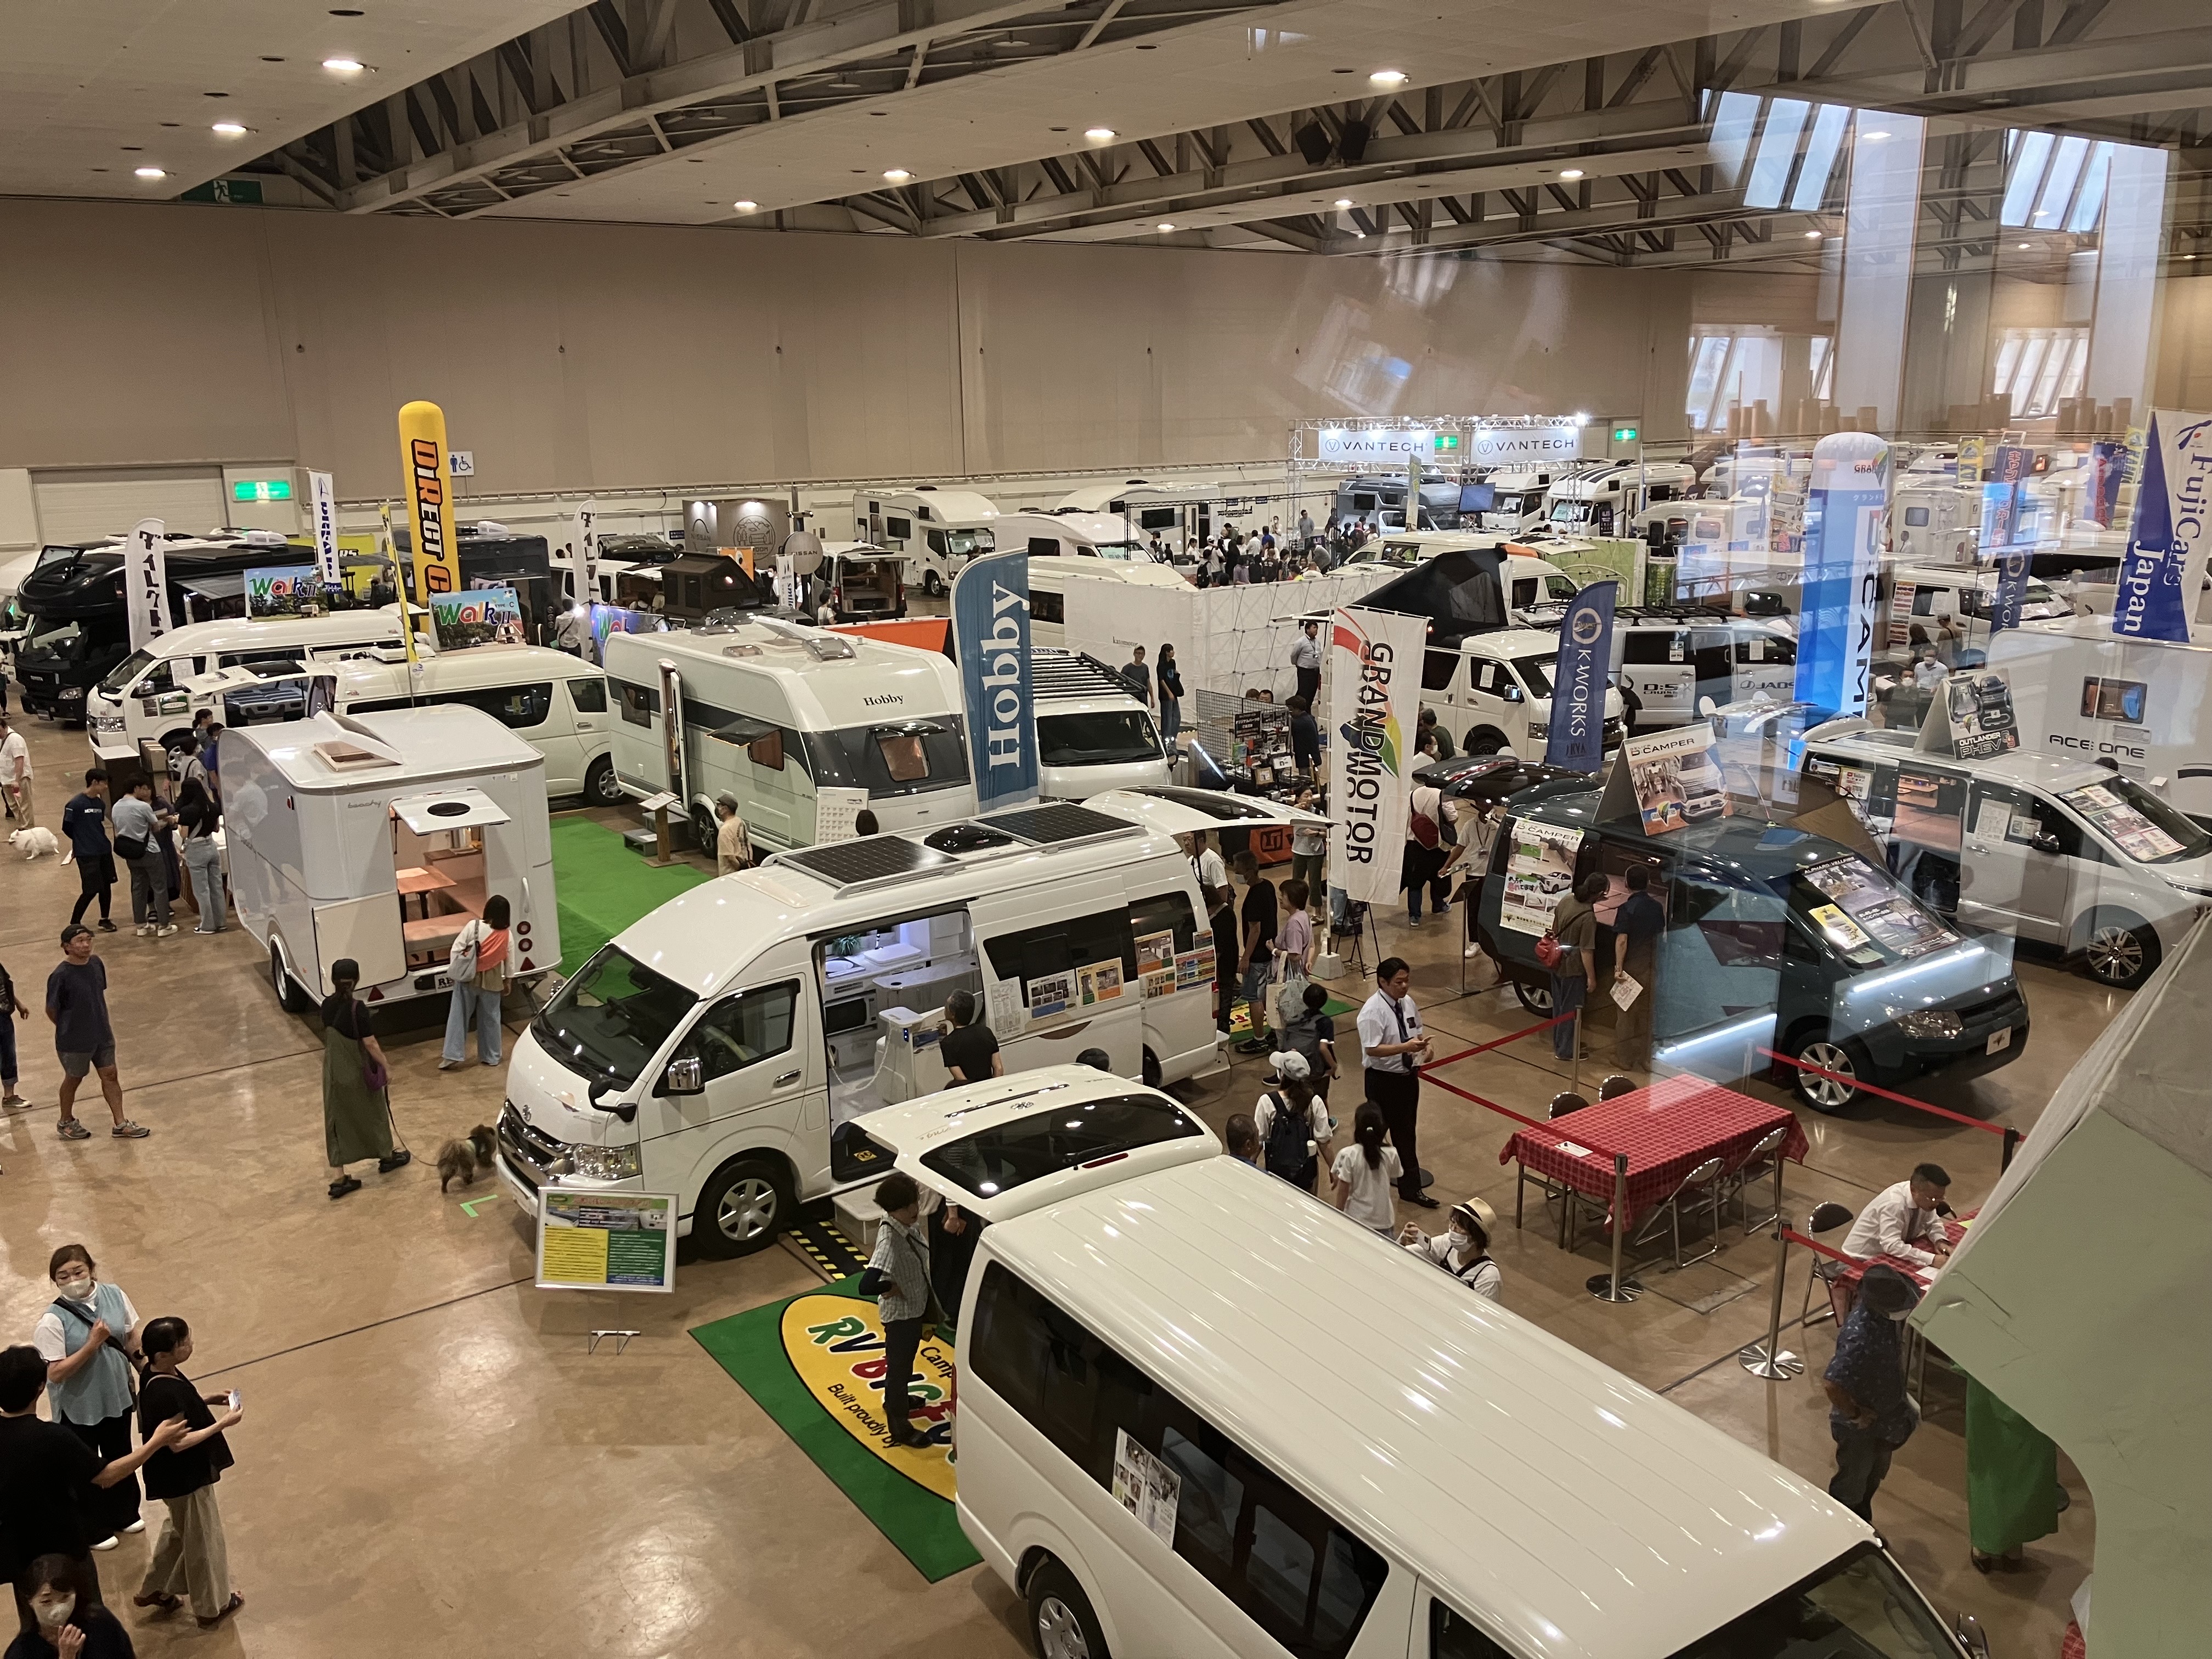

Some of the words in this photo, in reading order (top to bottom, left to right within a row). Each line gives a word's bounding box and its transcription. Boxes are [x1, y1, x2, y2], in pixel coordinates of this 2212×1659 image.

[1342, 441, 1424, 452] VANTECH
[1496, 439, 1575, 451] VANTECH
[411, 439, 445, 561] DIRECT
[249, 577, 305, 597] Walk
[2124, 540, 2165, 631] Japan
[435, 601, 499, 625] Walk
[1853, 510, 1881, 718] D:CAM
[980, 579, 1030, 771] Hobby
[862, 693, 904, 707] Hobby
[1959, 732, 2001, 746] OUTLANDER
[1960, 738, 2002, 758] PHEV
[2050, 735, 2094, 751] ACE
[2099, 742, 2145, 759] ONE
[348, 799, 382, 809] beachy
[827, 1383, 857, 1407] Built
[846, 1400, 888, 1436] proudly
